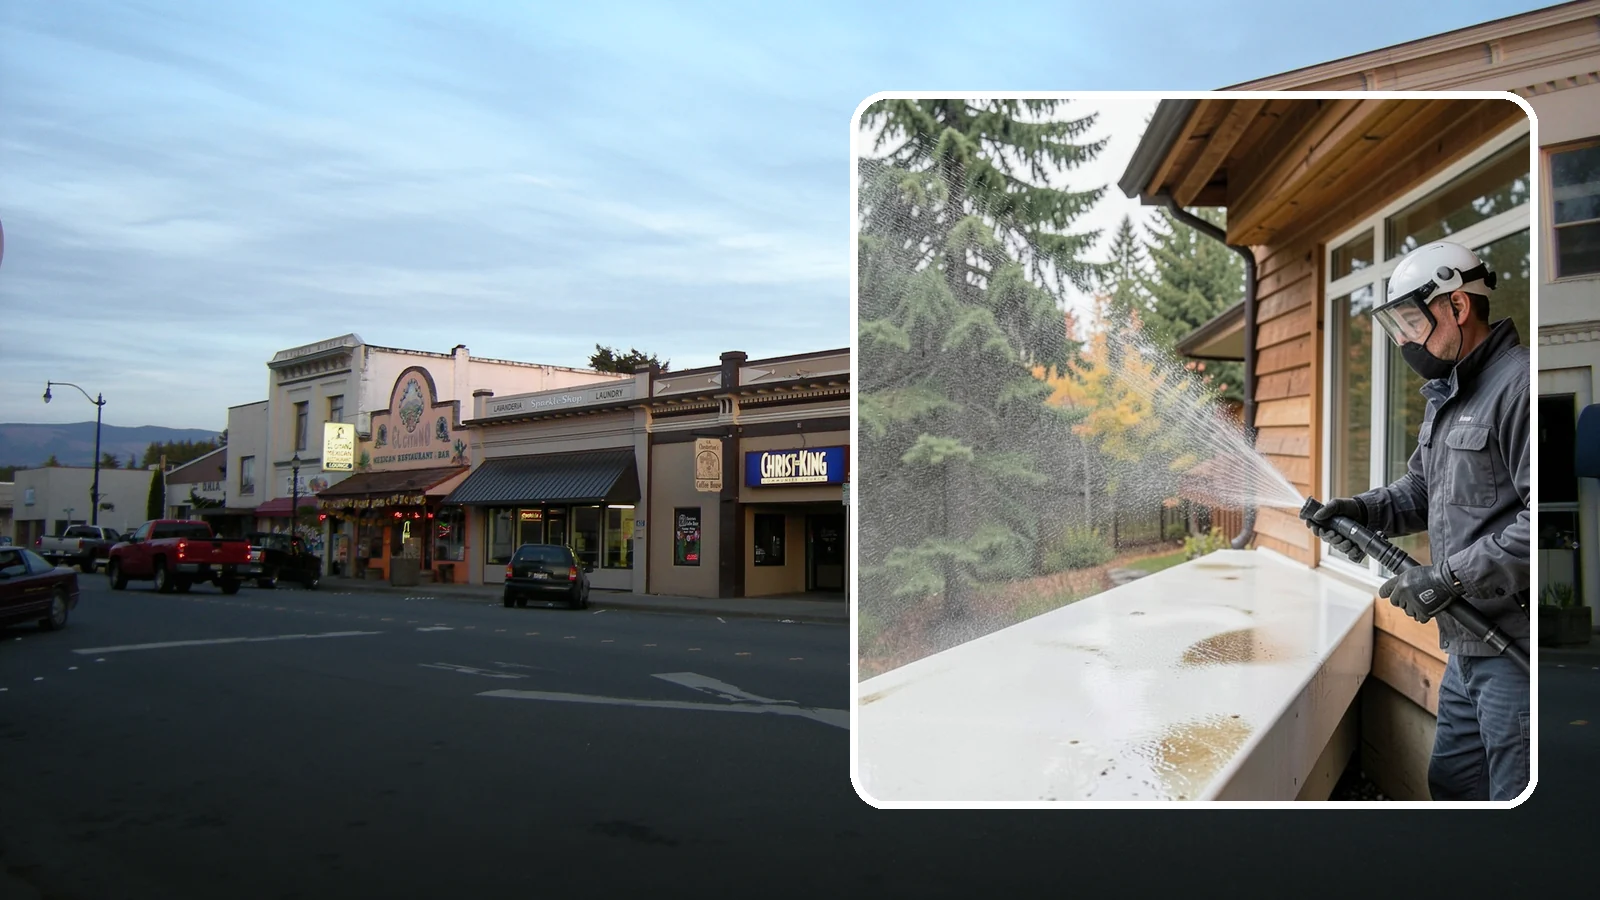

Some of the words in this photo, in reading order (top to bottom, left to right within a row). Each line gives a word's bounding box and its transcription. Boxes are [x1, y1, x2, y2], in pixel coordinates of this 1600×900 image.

[530, 395, 560, 410] Sparkle
[562, 393, 583, 405] Shop
[595, 389, 624, 400] LAUNDRY
[493, 401, 523, 413] LAVANDERIA
[373, 455, 396, 464] MEXICAN
[397, 451, 434, 462] RESTAURANT
[438, 450, 450, 459] BAR
[761, 452, 797, 478] CHRIST
[799, 450, 827, 476] KING
